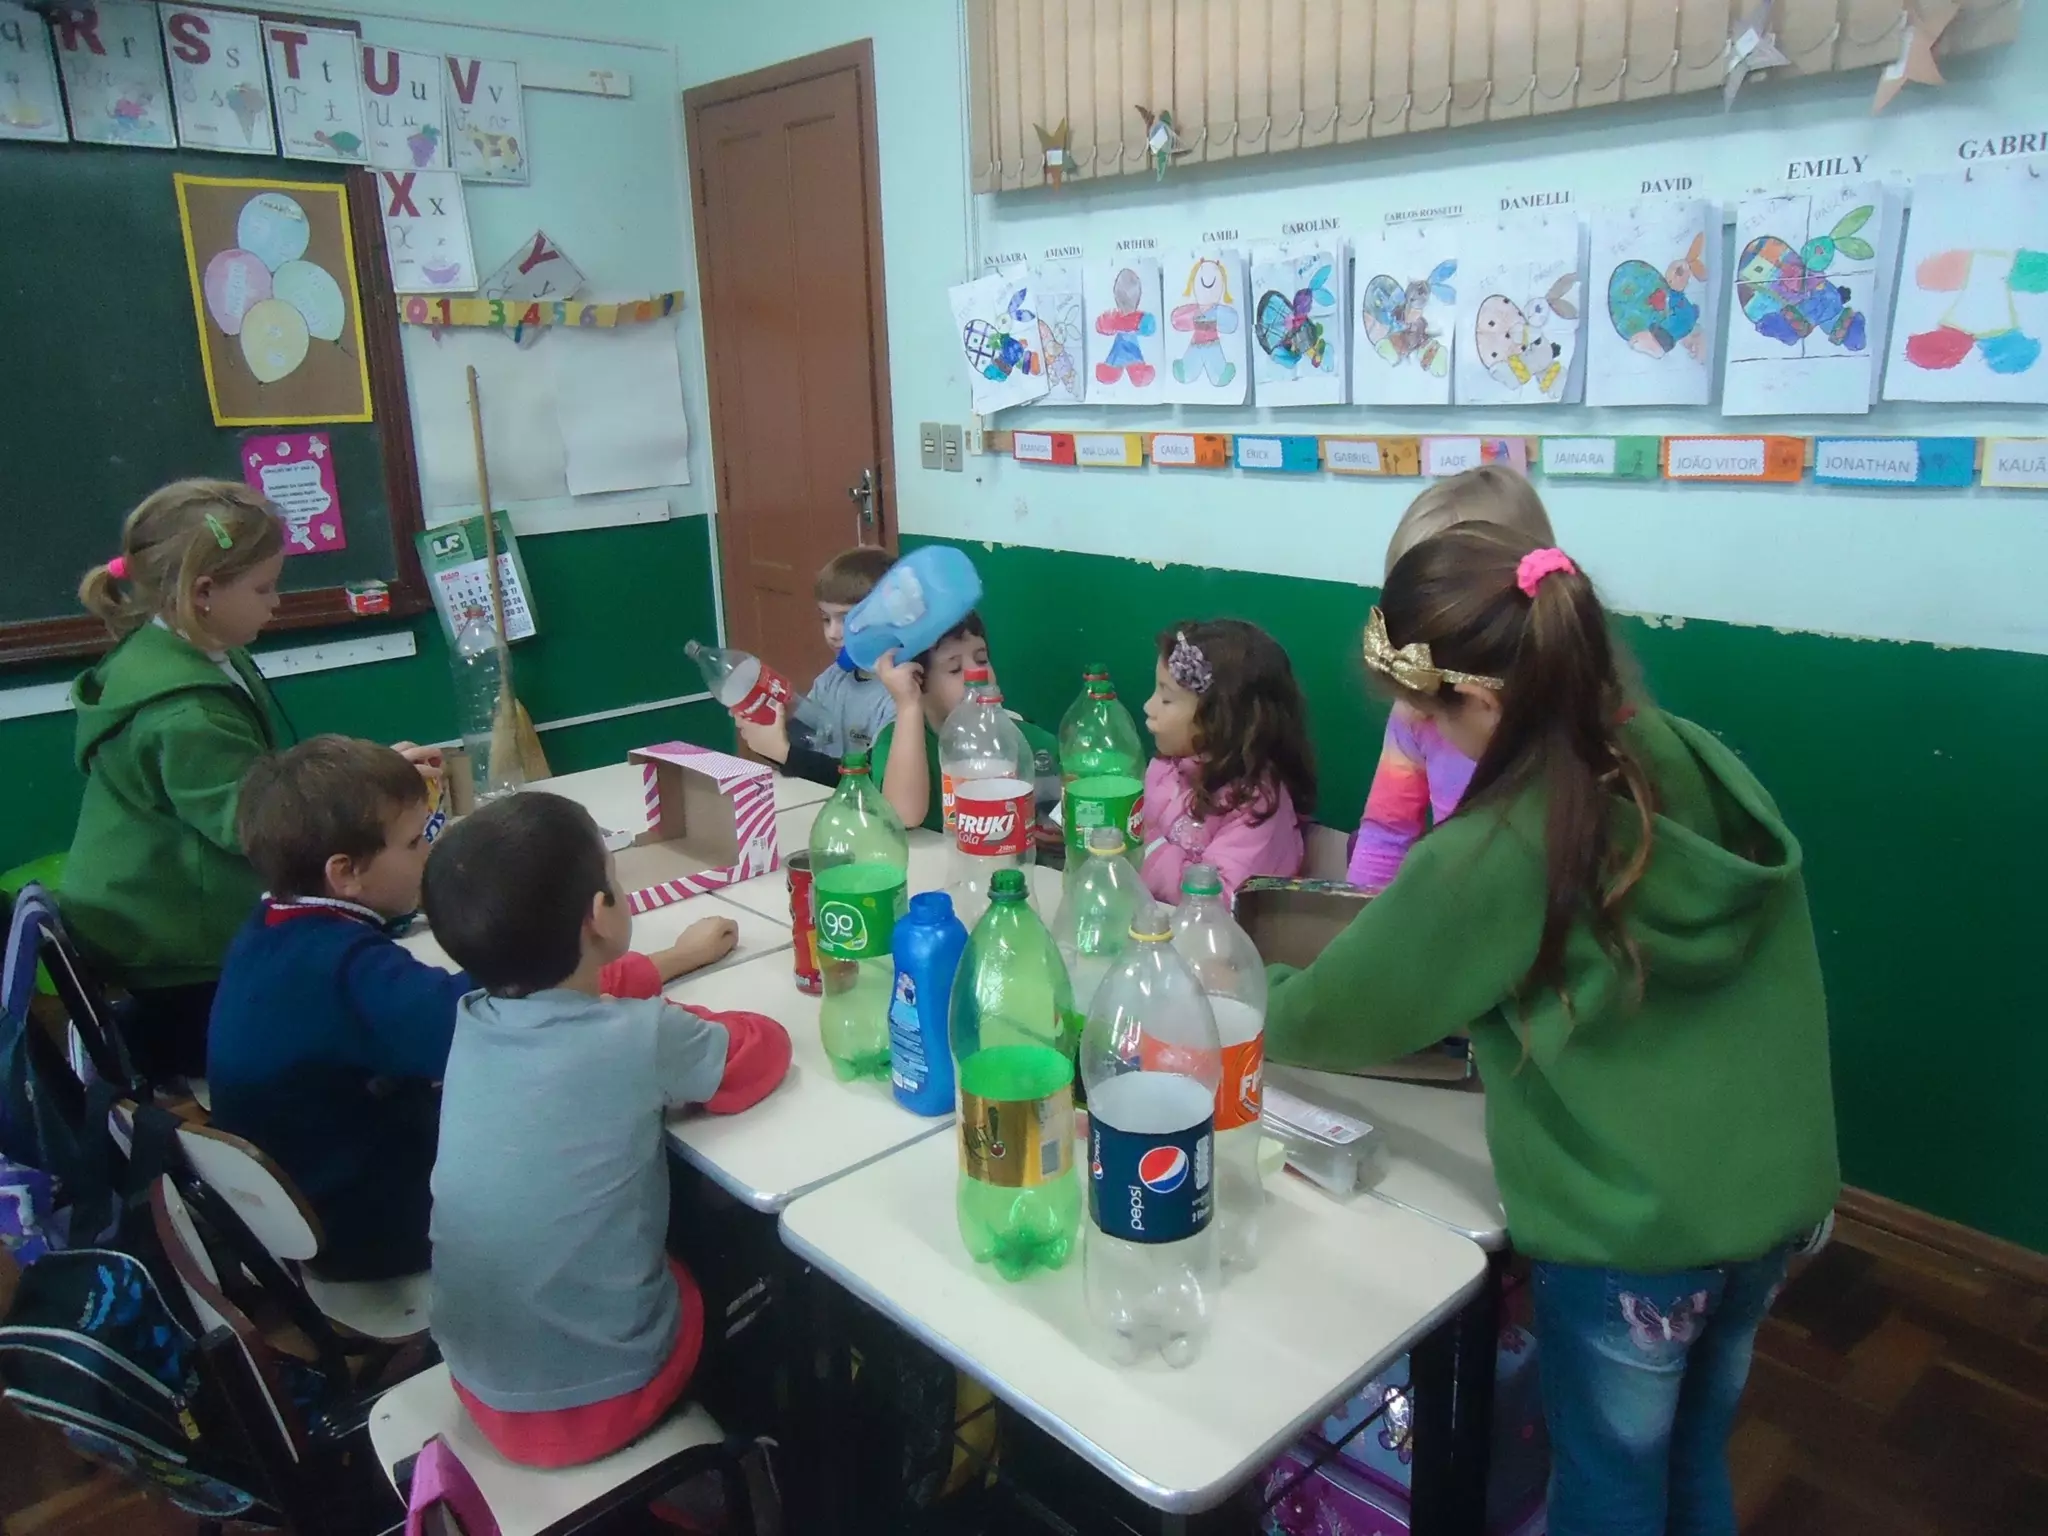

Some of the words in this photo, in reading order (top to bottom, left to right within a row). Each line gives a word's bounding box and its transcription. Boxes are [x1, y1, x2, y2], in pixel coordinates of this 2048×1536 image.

[50, 8, 107, 56] R
[121, 36, 137, 58] r
[169, 13, 211, 64] S
[225, 48, 241, 68] s
[271, 29, 308, 79] T
[321, 60, 333, 83] t
[363, 46, 400, 96] U
[410, 80, 427, 101] u
[448, 56, 482, 105] V
[488, 85, 503, 104] v
[1786, 154, 1868, 180] EMILY
[381, 172, 422, 217] X
[428, 198, 446, 216] x
[1641, 177, 1692, 194] DAVID
[1500, 190, 1570, 211] DANIELLI
[1282, 217, 1340, 235] CAROLINE
[518, 232, 560, 275] Y
[1044, 246, 1081, 259] AMANDA
[1115, 238, 1155, 251] ARTHUR
[436, 299, 451, 325] 1
[488, 299, 506, 326] 3
[522, 302, 541, 325] 4
[552, 301, 567, 324] 5
[579, 304, 598, 326] 6
[1160, 443, 1190, 456] CAMILA
[1246, 448, 1269, 460] ERICK
[1334, 451, 1373, 464] GABRIEL
[1554, 451, 1605, 465] JAINARA
[1440, 454, 1467, 467] JADE
[1676, 454, 1712, 470] JOÃO
[1715, 457, 1759, 471] VITOR
[1825, 456, 1912, 474] JONATHAN
[1998, 456, 2047, 473] KAUÃ
[958, 813, 1015, 835] FRUKI
[958, 831, 980, 845] Cola
[1093, 1130, 1101, 1162] pepsi
[1128, 1185, 1145, 1230] pepsi
